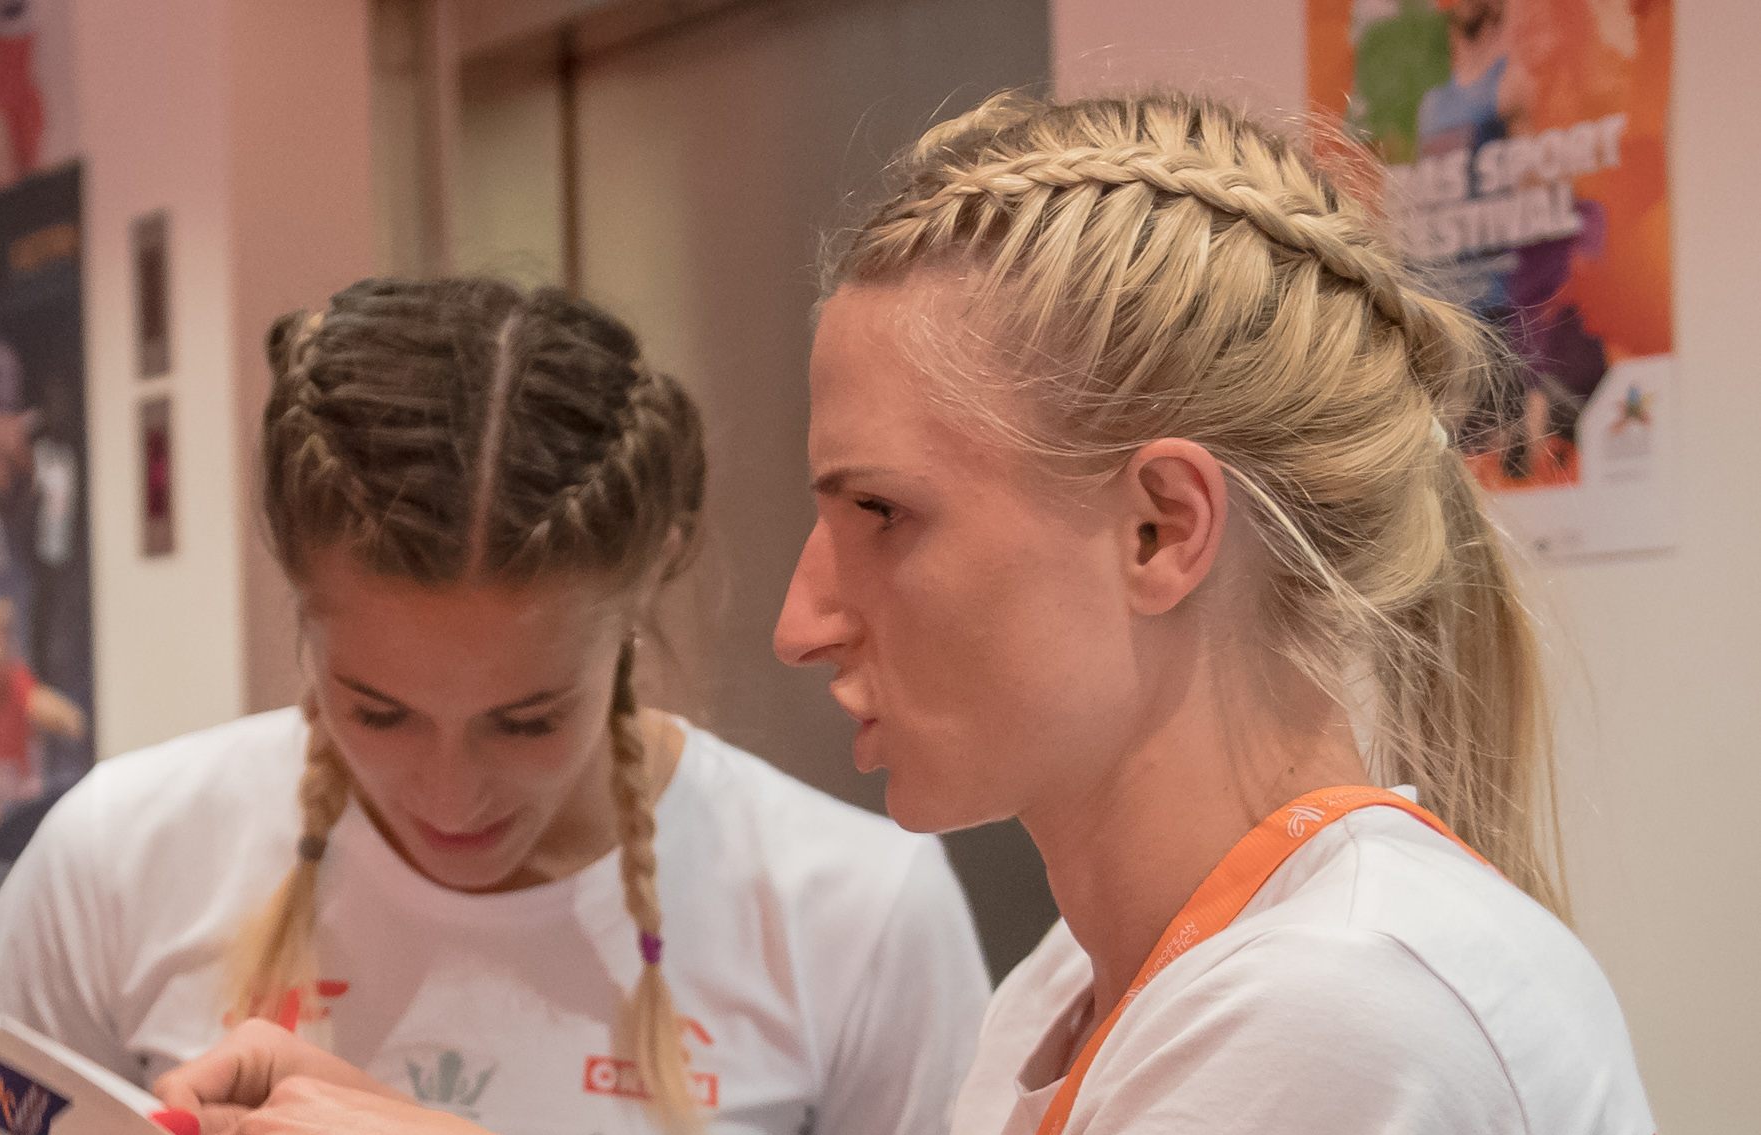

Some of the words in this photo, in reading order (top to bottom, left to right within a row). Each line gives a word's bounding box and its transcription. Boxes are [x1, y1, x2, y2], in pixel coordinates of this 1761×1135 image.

[1475, 111, 1629, 193] SPORT
[1387, 176, 1585, 257] ESTIVAL
[1145, 920, 1196, 983] EUROPEAN
